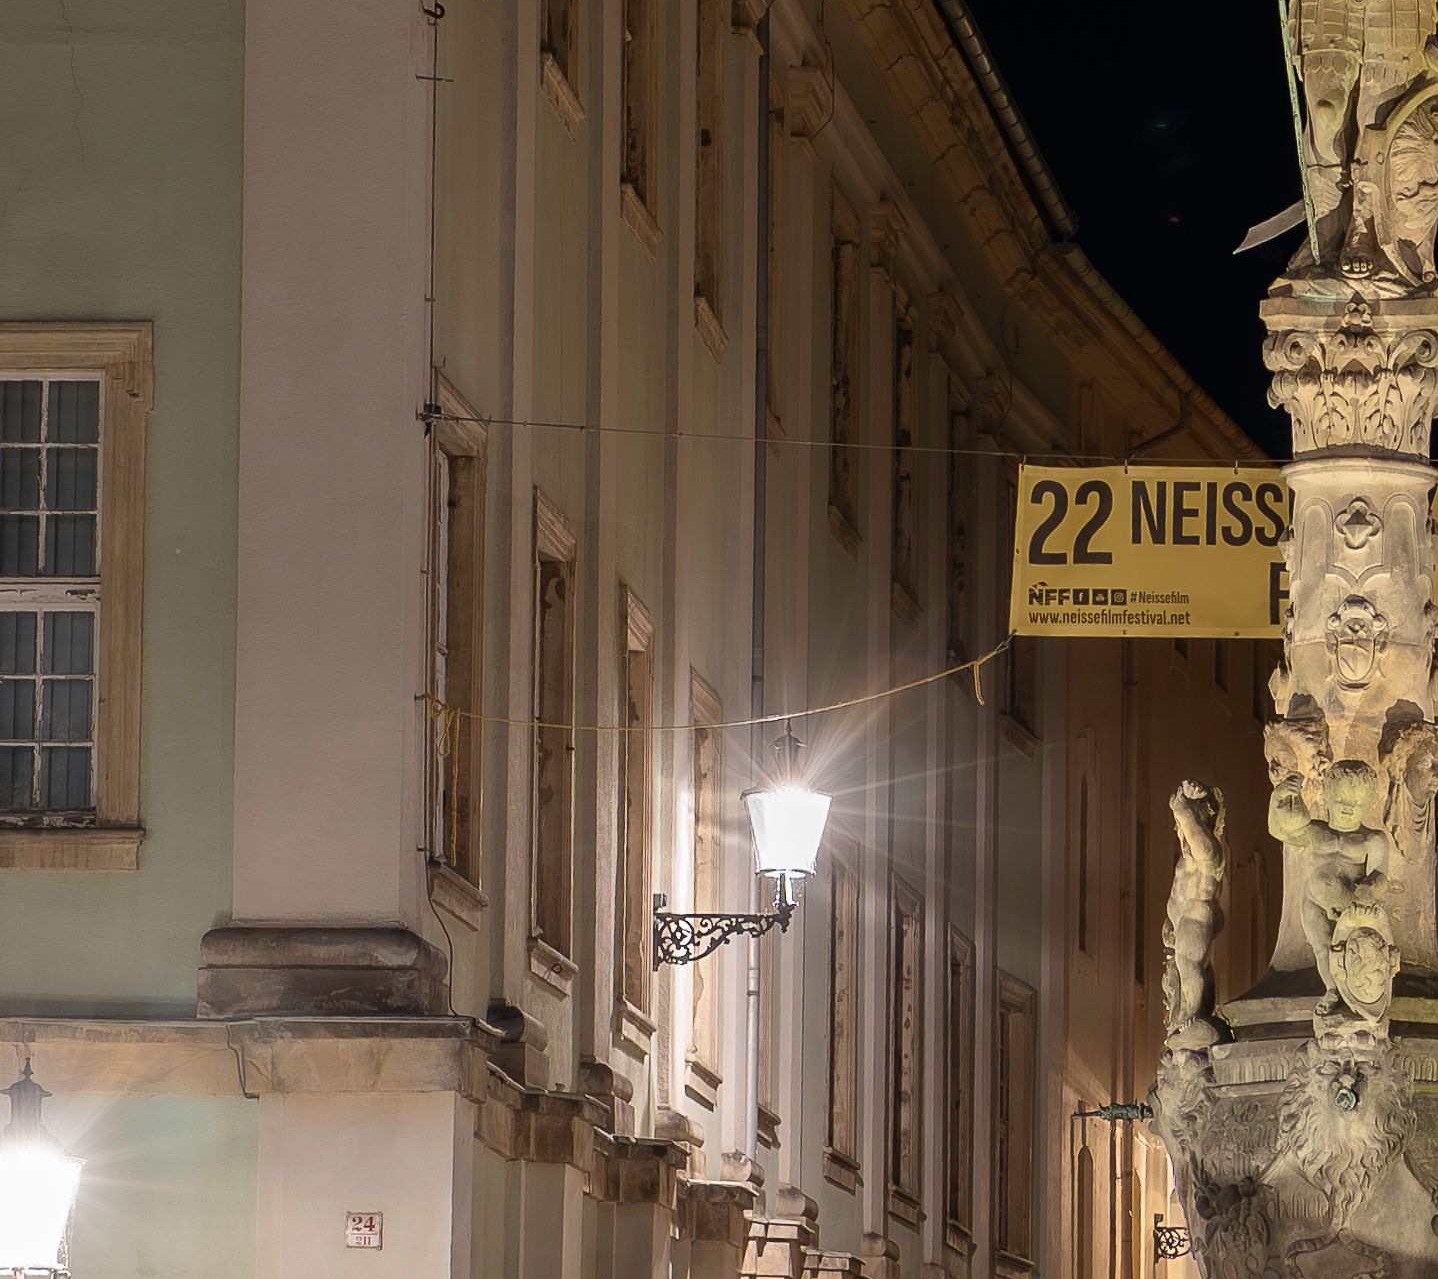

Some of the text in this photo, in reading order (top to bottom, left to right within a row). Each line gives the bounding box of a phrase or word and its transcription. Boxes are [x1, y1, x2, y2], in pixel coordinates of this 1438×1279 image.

[1028, 480, 1113, 565] 22
[1131, 480, 1295, 547] NEISS
[1028, 608, 1191, 626] www.neissefilmfestival.net
[352, 1216, 376, 1232] 24
